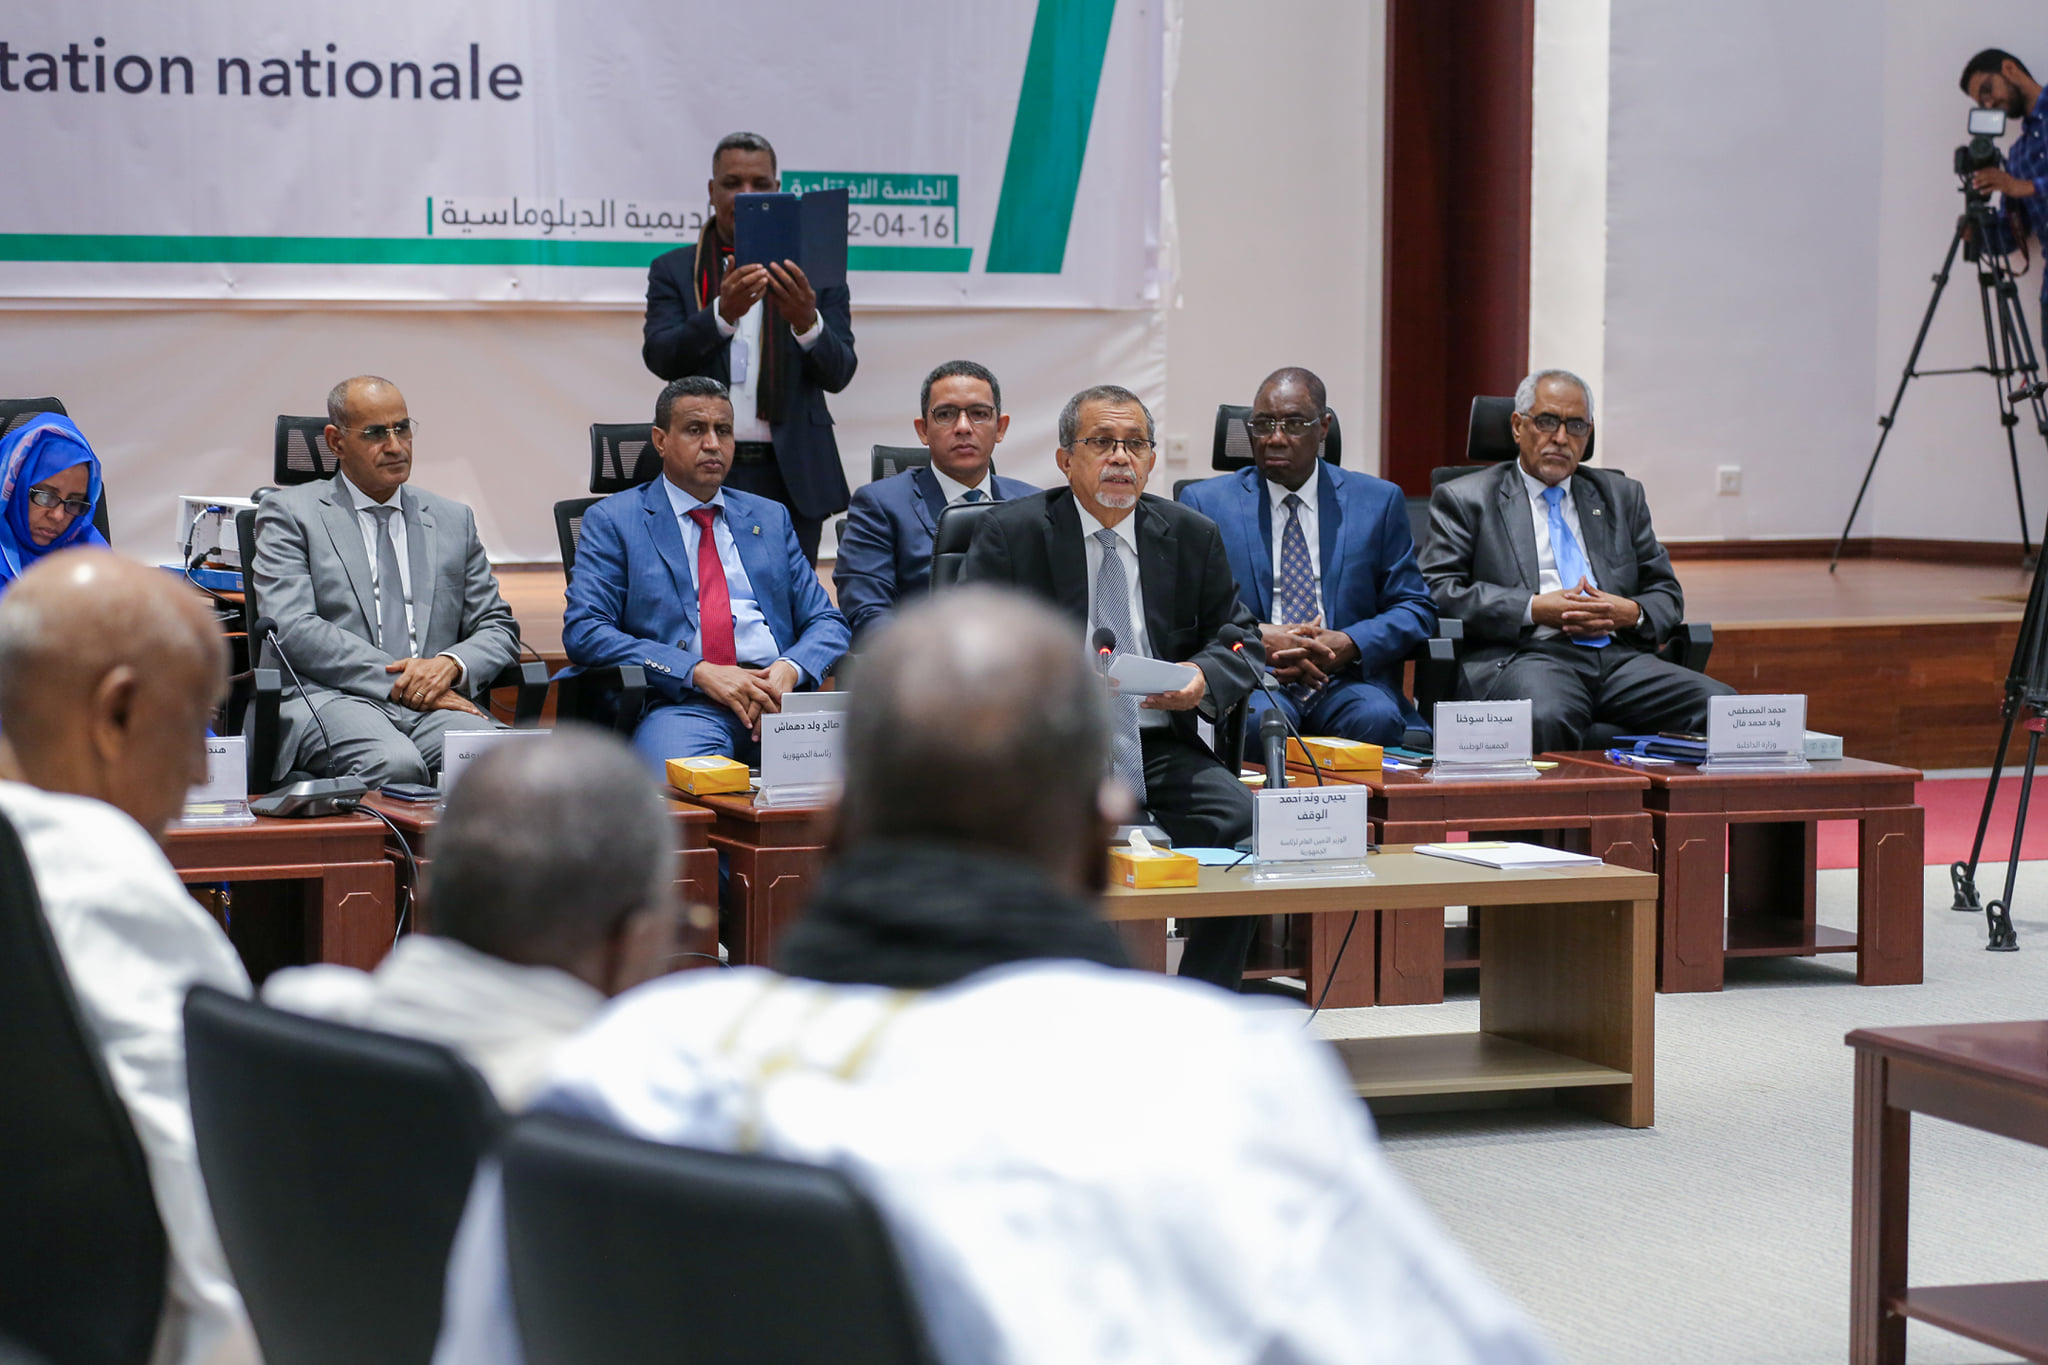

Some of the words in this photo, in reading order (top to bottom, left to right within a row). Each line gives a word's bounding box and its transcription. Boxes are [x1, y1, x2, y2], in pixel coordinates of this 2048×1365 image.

[0, 36, 194, 94] tation
[217, 43, 524, 102] nationale
[881, 178, 948, 205] الجلسة
[441, 197, 615, 235] الدبلوماسية
[1727, 706, 1766, 717] المصطفى
[1487, 712, 1513, 725] سيدنا
[1748, 719, 1767, 727] محمد
[1769, 718, 1781, 728] ولد
[774, 721, 805, 734] دهماش
[807, 720, 820, 732] ولد
[822, 719, 840, 733] صالح
[782, 748, 812, 761] الجمهورية
[814, 747, 832, 759] رئاسة
[1279, 789, 1301, 804] أحمد
[1297, 808, 1328, 822] الوقف
